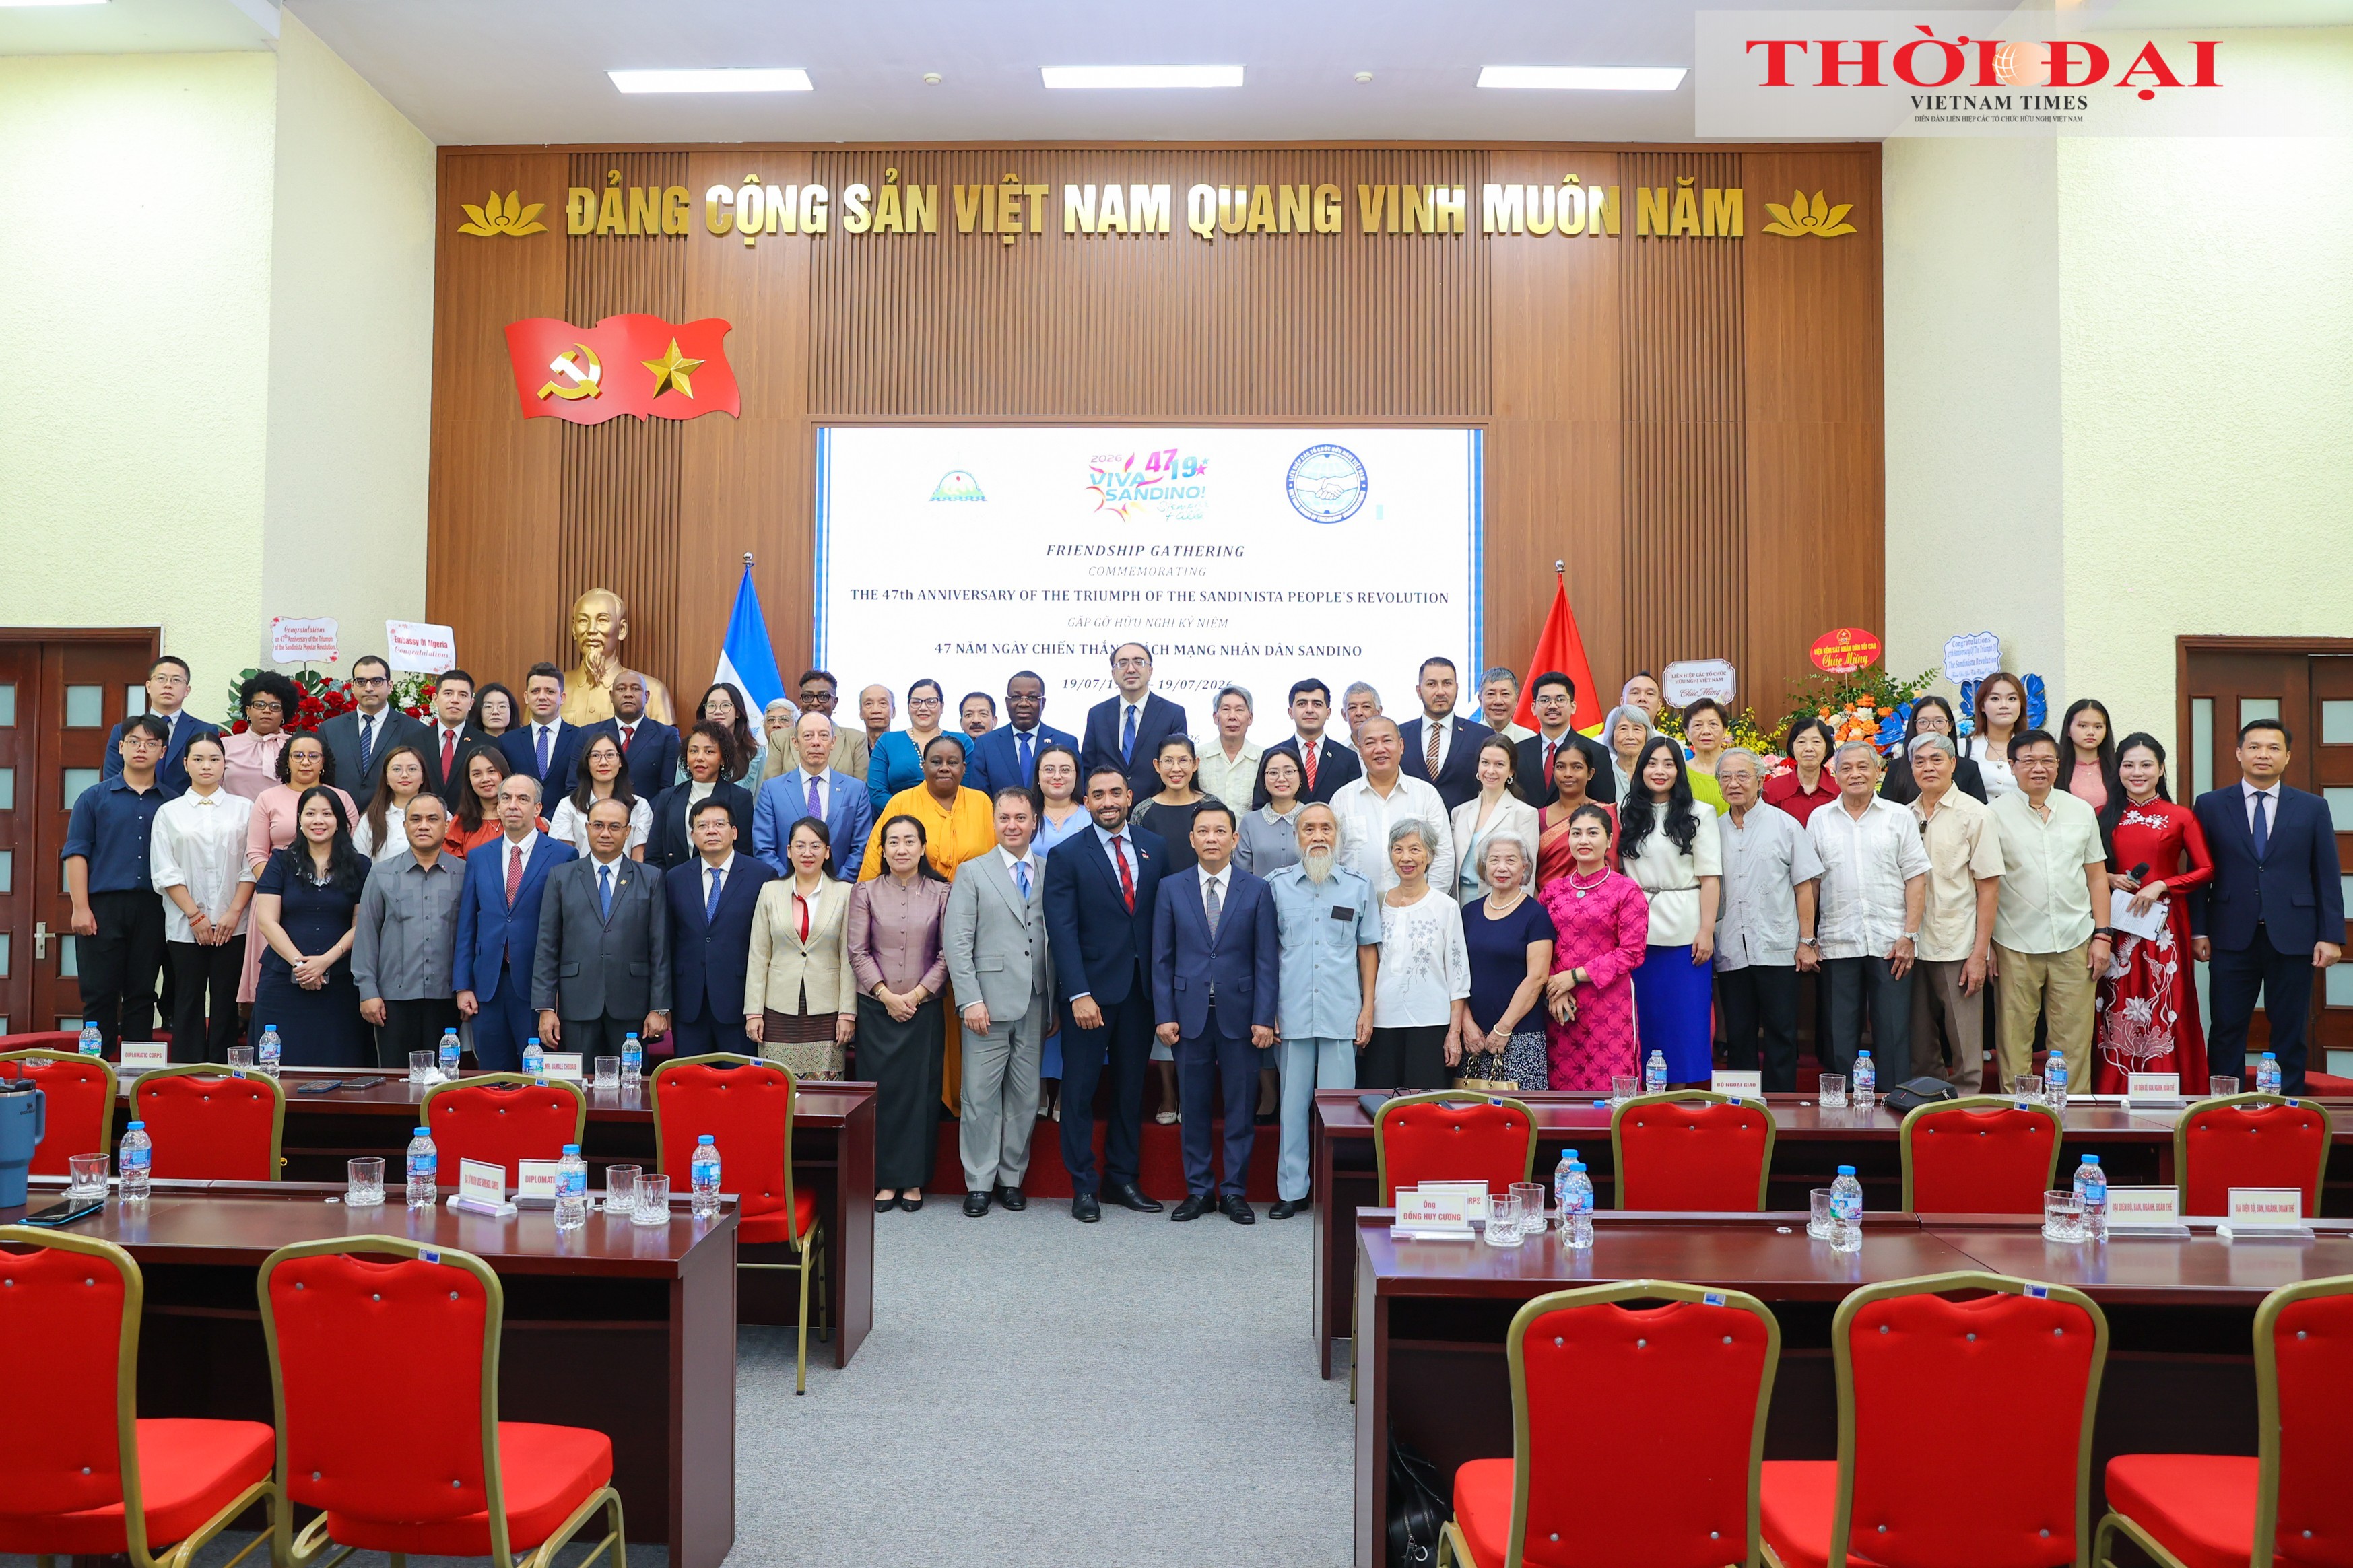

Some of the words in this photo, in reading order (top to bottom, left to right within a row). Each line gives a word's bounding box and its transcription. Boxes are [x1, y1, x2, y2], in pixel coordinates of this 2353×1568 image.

[566, 169, 690, 235] ĐẢNG
[705, 174, 829, 245] CỘNG
[844, 168, 937, 234] SẢN
[953, 173, 1049, 244] VIỆT
[1064, 184, 1170, 234] NAM
[1187, 184, 1341, 240] QUANG
[1358, 184, 1467, 235] VINH
[1482, 174, 1620, 236] MUÔN
[1637, 176, 1744, 237] NĂM
[1090, 454, 1123, 463] 2026
[1145, 448, 1178, 473] 47
[1168, 456, 1197, 481] 19
[1090, 472, 1146, 487] VIVA
[1105, 486, 1206, 502] SANDINO!
[1046, 545, 1145, 557] FRIENDSHIP
[1150, 545, 1245, 558] GATHERING
[1088, 566, 1207, 577] COMMEMORATING
[851, 589, 879, 601] THE
[882, 589, 913, 601] 47th
[917, 590, 1016, 601] ANNIVERSARY
[1020, 590, 1037, 601] OF
[1041, 590, 1069, 601] THE
[1074, 590, 1140, 602] TRIUMPH
[1145, 590, 1164, 602] OF
[1167, 591, 1195, 603] THE
[1199, 591, 1284, 603] SANDINISTA
[1288, 591, 1353, 603] PEOPLE'S
[1358, 592, 1449, 604] REVOLUTION
[1115, 615, 1143, 628] HỮU
[284, 625, 325, 634] Congratulations
[394, 636, 419, 646] Embassy
[428, 639, 448, 648] Algeria
[1952, 637, 1991, 648] Congratulations
[395, 646, 449, 658] Congratulations
[935, 643, 951, 654] 47
[956, 640, 987, 654] NĂM
[991, 641, 1028, 654] NGÀY
[1032, 640, 1075, 654] CHIẾN
[1079, 640, 1119, 655] THẮN
[1174, 644, 1216, 658] MẠNG
[1220, 642, 1260, 656] NHÂN
[1265, 642, 1294, 656] DÂN
[1298, 644, 1362, 657] SANDINO
[1814, 647, 1823, 656] VIỆN
[1841, 644, 1851, 652] NHÂN
[1822, 654, 1843, 668] Chúc
[1843, 652, 1869, 667] Mừng
[1680, 689, 1698, 697] Chúc
[1698, 687, 1721, 698] Mừng
[1424, 1200, 1436, 1209] Ông
[1438, 1213, 1461, 1221] CƯƠNG
